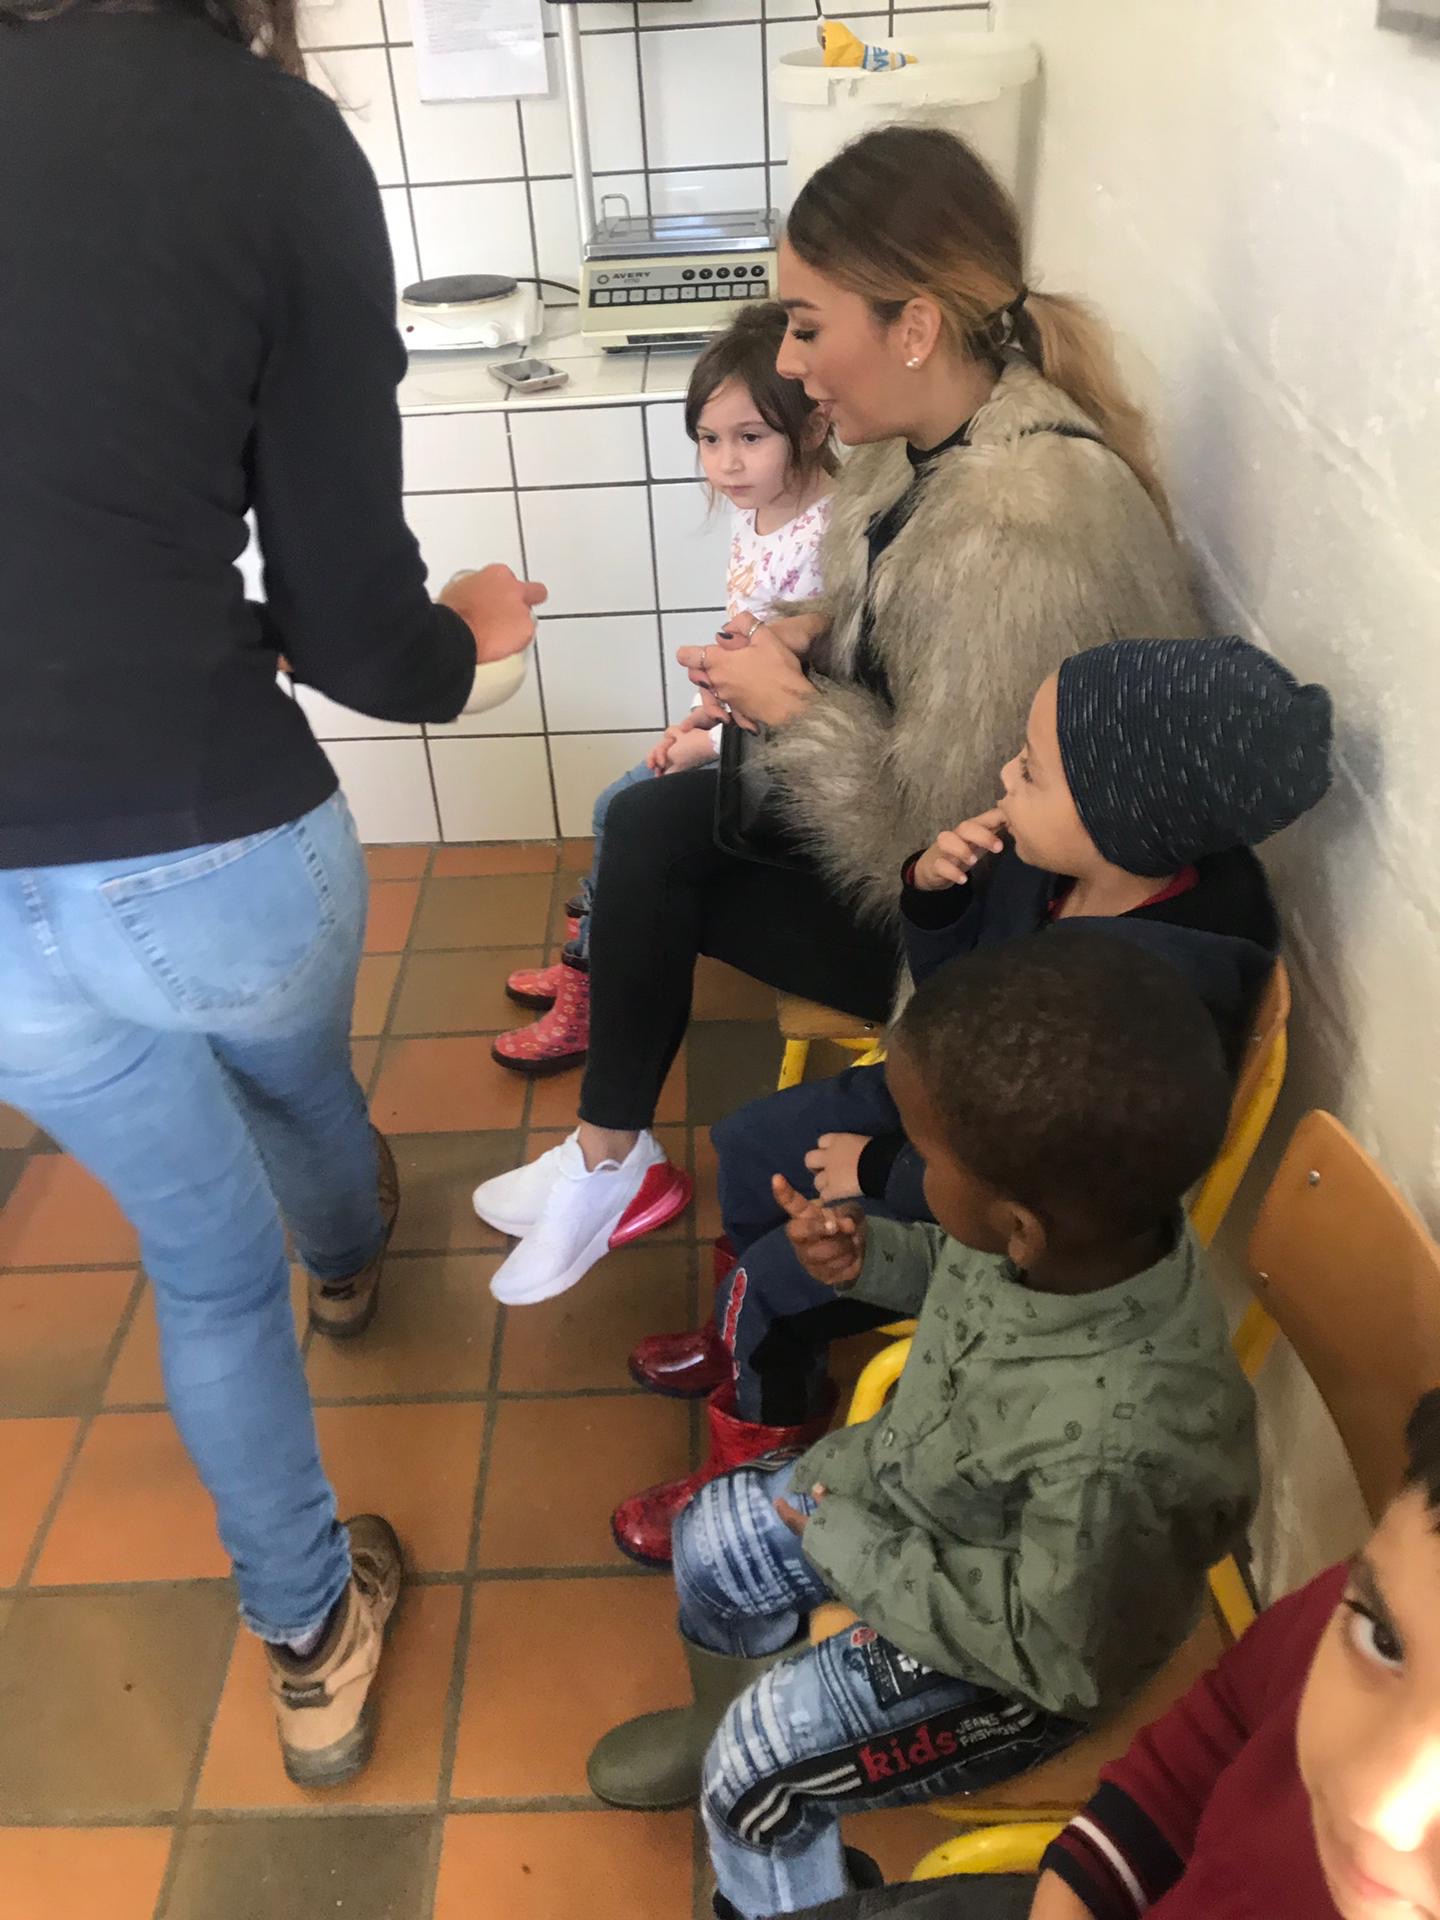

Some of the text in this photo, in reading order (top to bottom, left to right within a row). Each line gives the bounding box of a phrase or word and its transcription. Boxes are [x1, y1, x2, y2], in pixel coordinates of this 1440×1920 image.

[612, 271, 651, 279] AVERY
[956, 1712, 1000, 1735] JEANS
[859, 1721, 1021, 1782] kids FASHION
